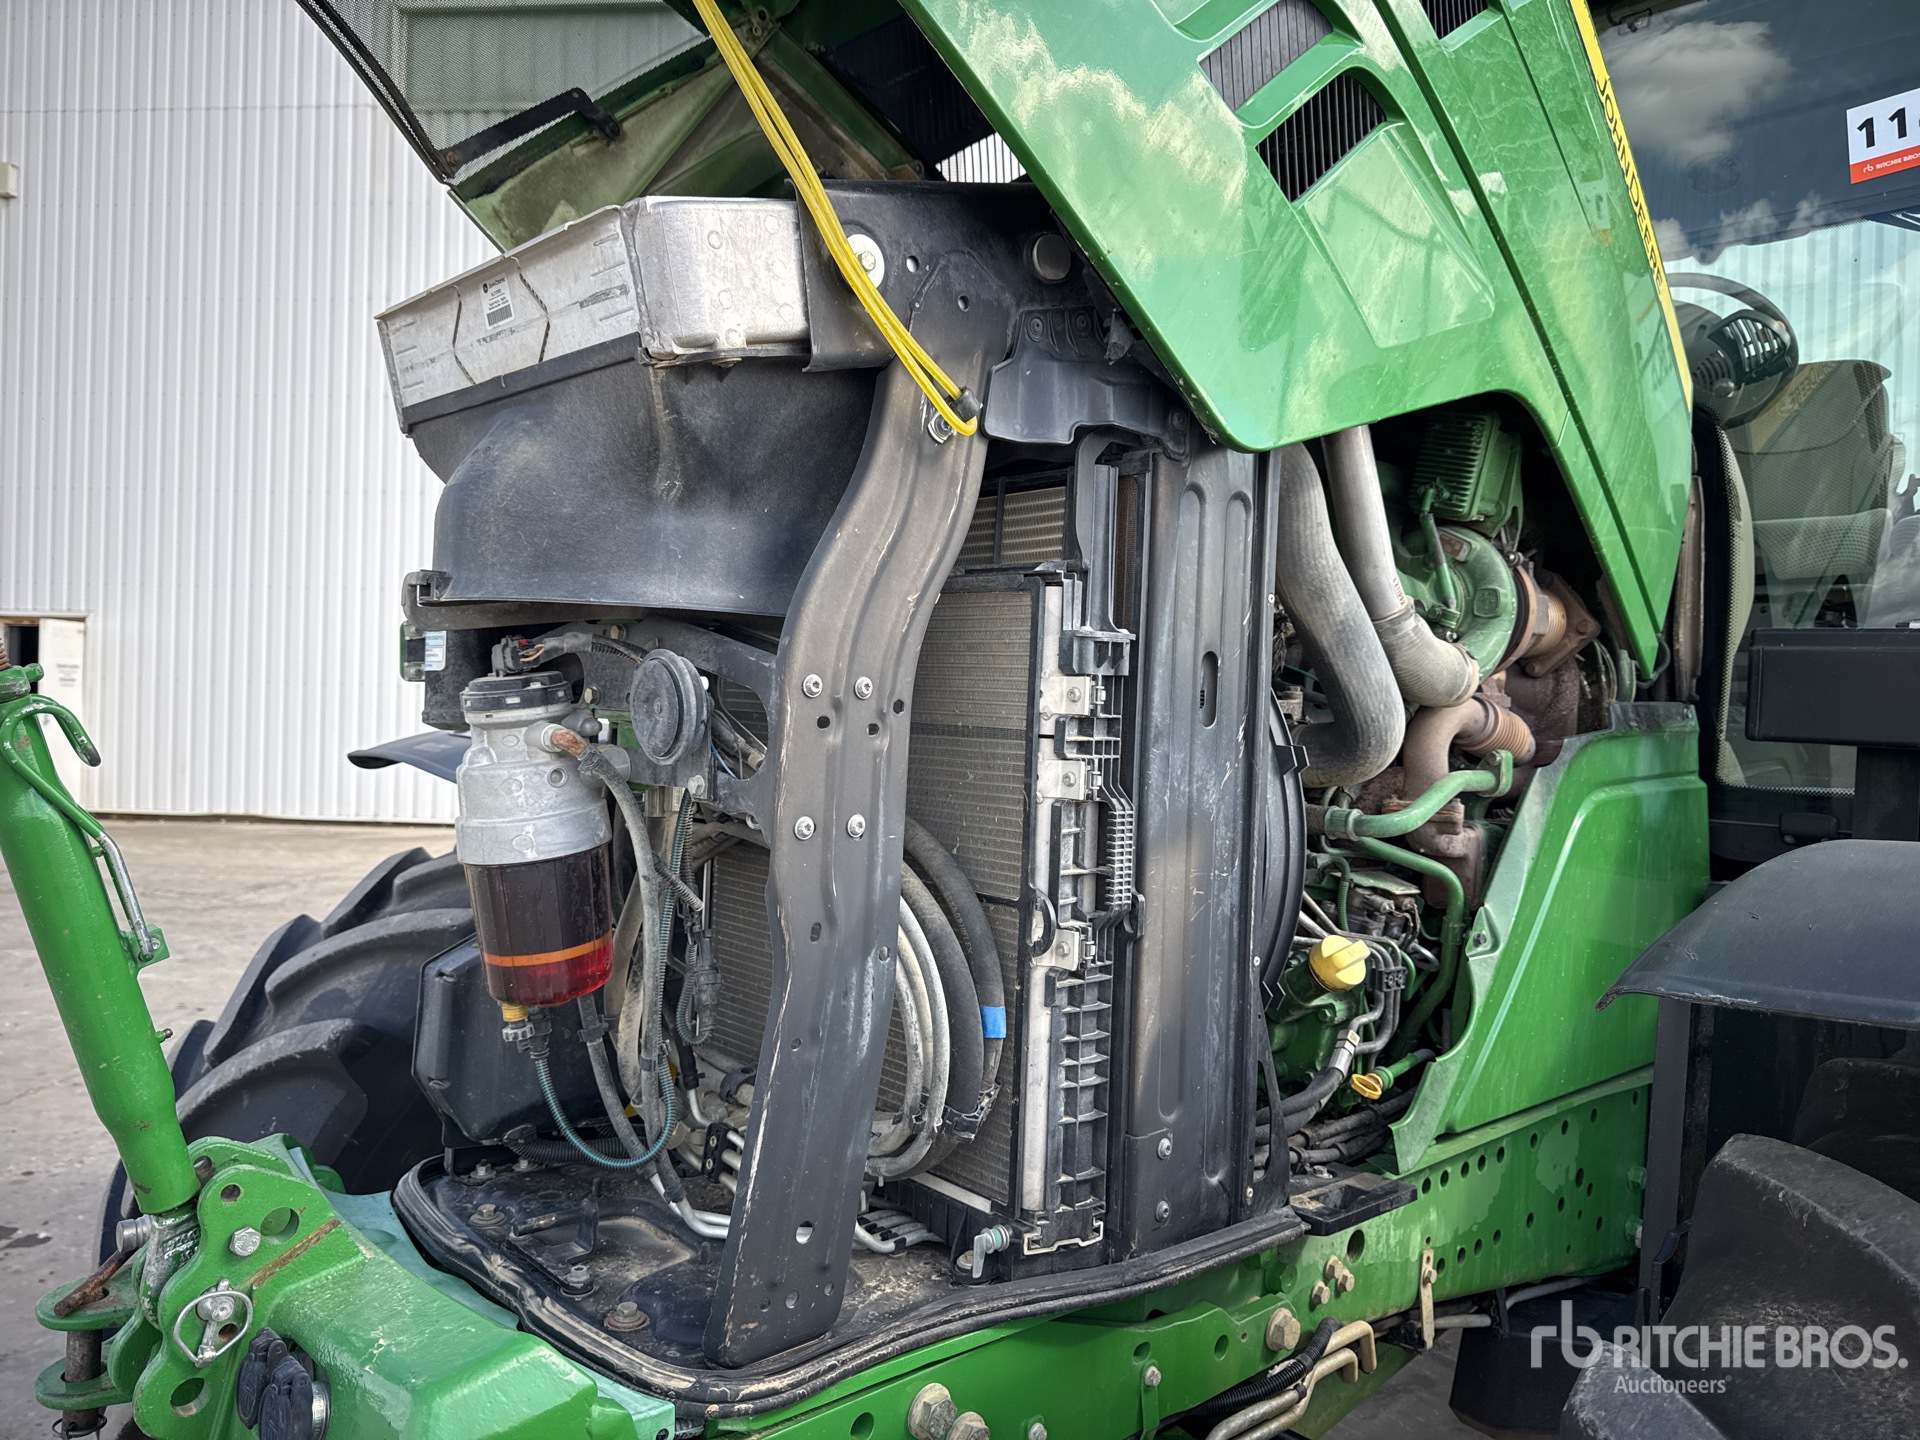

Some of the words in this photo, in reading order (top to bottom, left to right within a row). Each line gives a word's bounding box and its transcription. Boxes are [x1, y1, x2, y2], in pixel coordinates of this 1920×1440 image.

[1857, 107, 1920, 148] 11
[1597, 78, 1630, 176] JOHN
[1628, 172, 1664, 290] DEERE
[1876, 157, 1902, 170] RITCHIE
